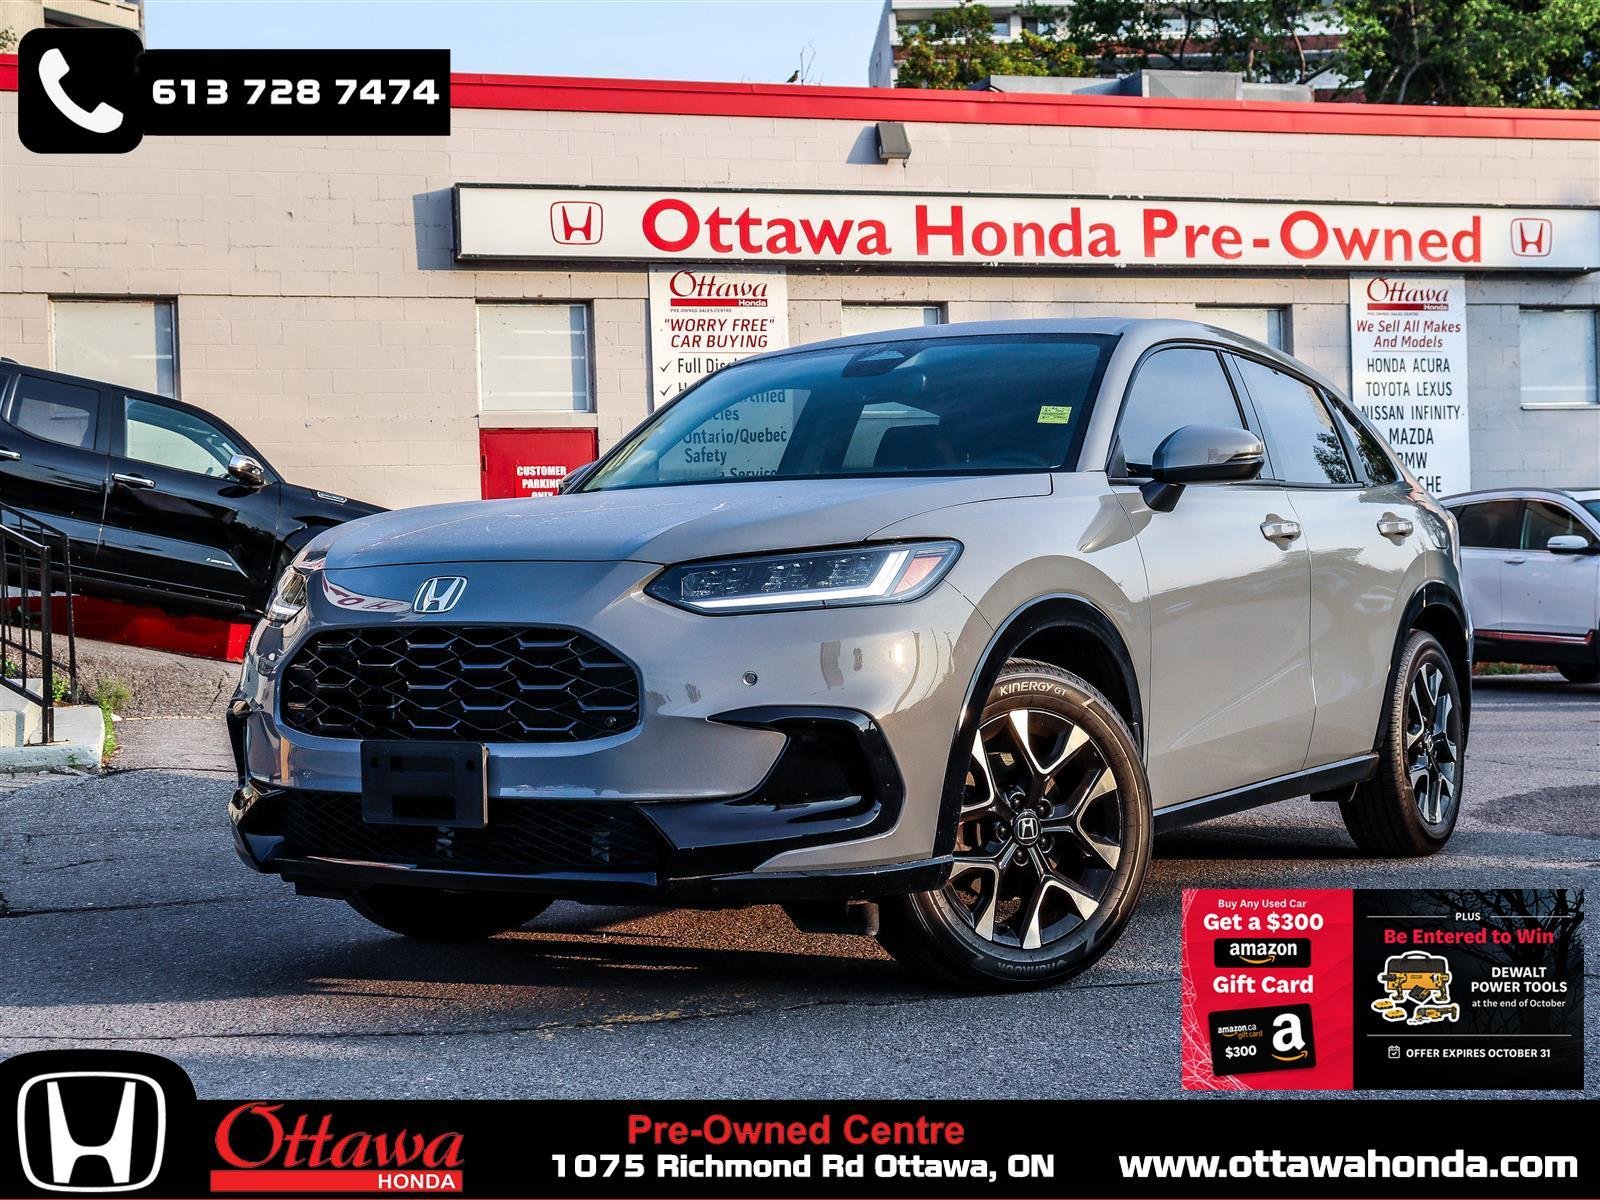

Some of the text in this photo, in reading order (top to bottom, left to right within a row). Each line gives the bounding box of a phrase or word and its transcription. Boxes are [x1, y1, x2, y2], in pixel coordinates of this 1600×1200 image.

[642, 198, 892, 256] Ottawa
[916, 204, 1120, 259] Honda
[669, 270, 768, 297] Ottawa
[1366, 276, 1449, 302] Ottawa
[738, 299, 767, 307] Honda
[1423, 303, 1449, 311] Honda
[665, 318, 775, 332] "WORRY FREE"
[1357, 320, 1462, 333] We Sell All Makes
[671, 334, 768, 348] CAR BUYING
[1374, 335, 1443, 348] And Models
[678, 357, 702, 373] Full
[1367, 358, 1451, 373] HONDA ACURA
[1366, 381, 1453, 397] TOYOTA LEXUS
[1361, 405, 1461, 420] NISSAN INFINITY
[1389, 427, 1434, 445] MAZDA
[685, 448, 727, 465] Safety
[517, 465, 567, 476] CUSTOMER
[1054, 686, 1068, 696] GT
